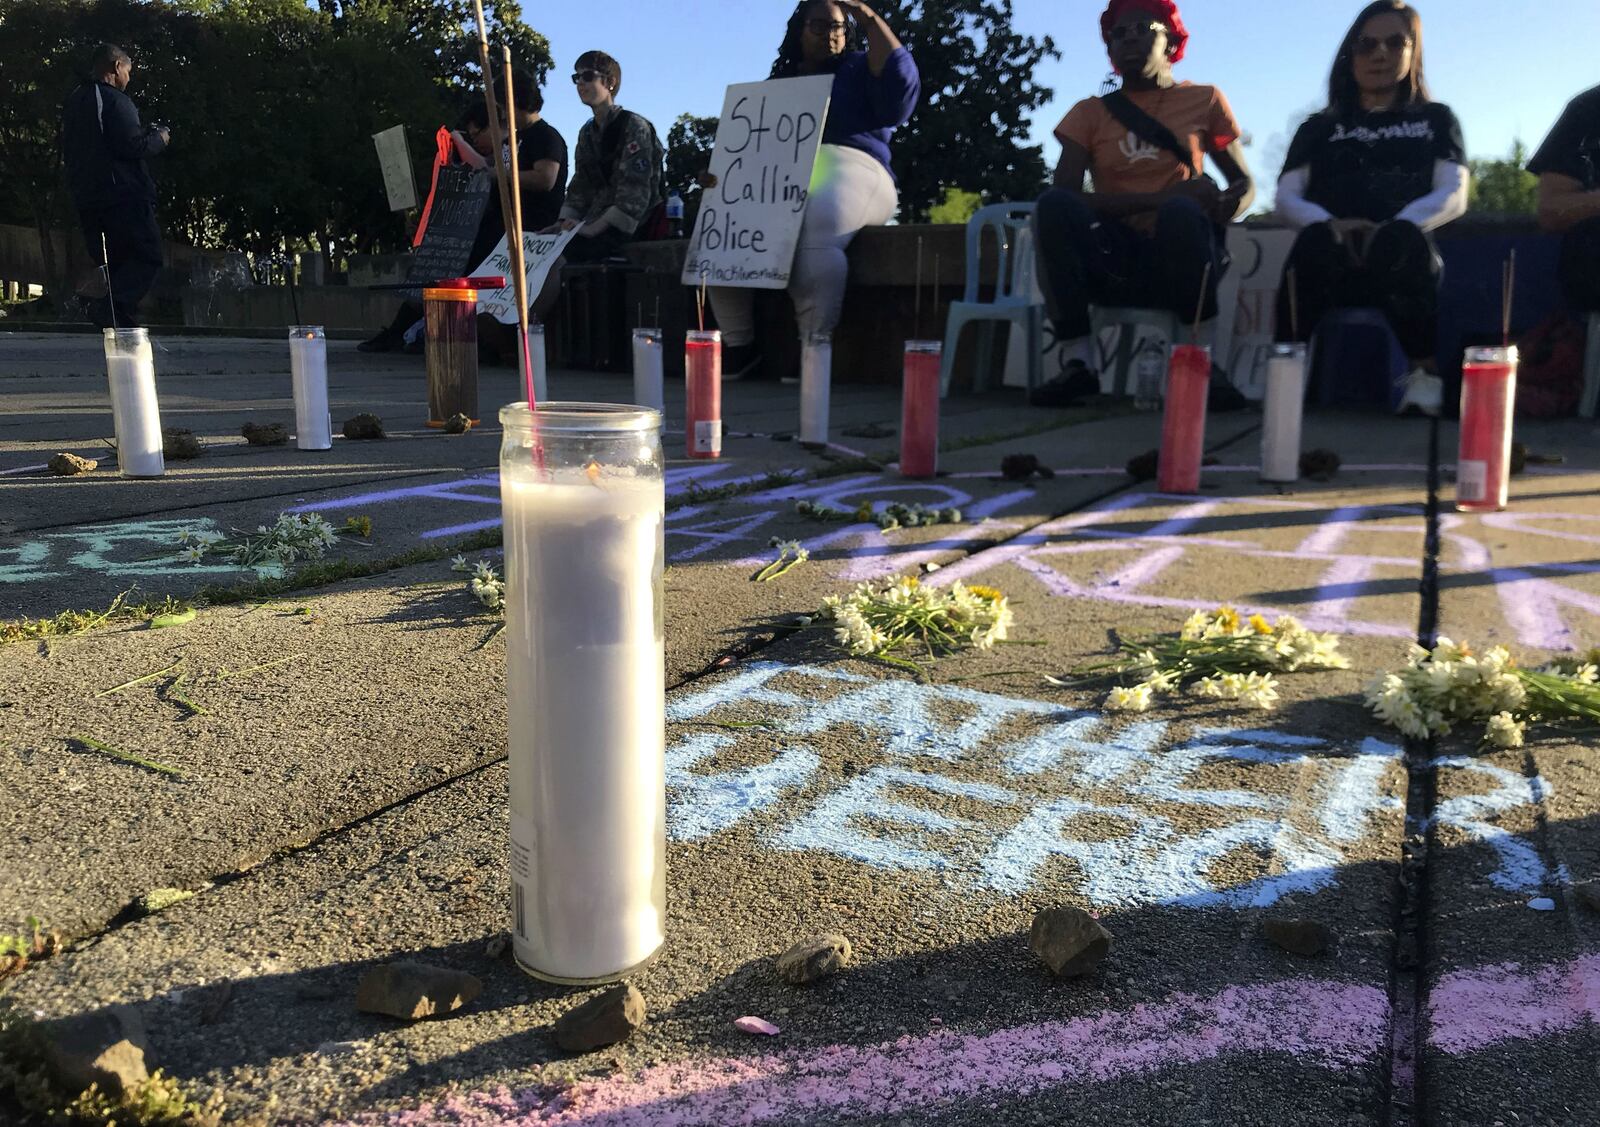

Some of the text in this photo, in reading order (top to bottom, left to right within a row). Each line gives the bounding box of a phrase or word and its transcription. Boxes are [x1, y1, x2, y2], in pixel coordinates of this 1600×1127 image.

[724, 96, 817, 163] Stop
[721, 158, 808, 213] Calling
[697, 208, 768, 253] Police
[666, 661, 1568, 894] FATHER
